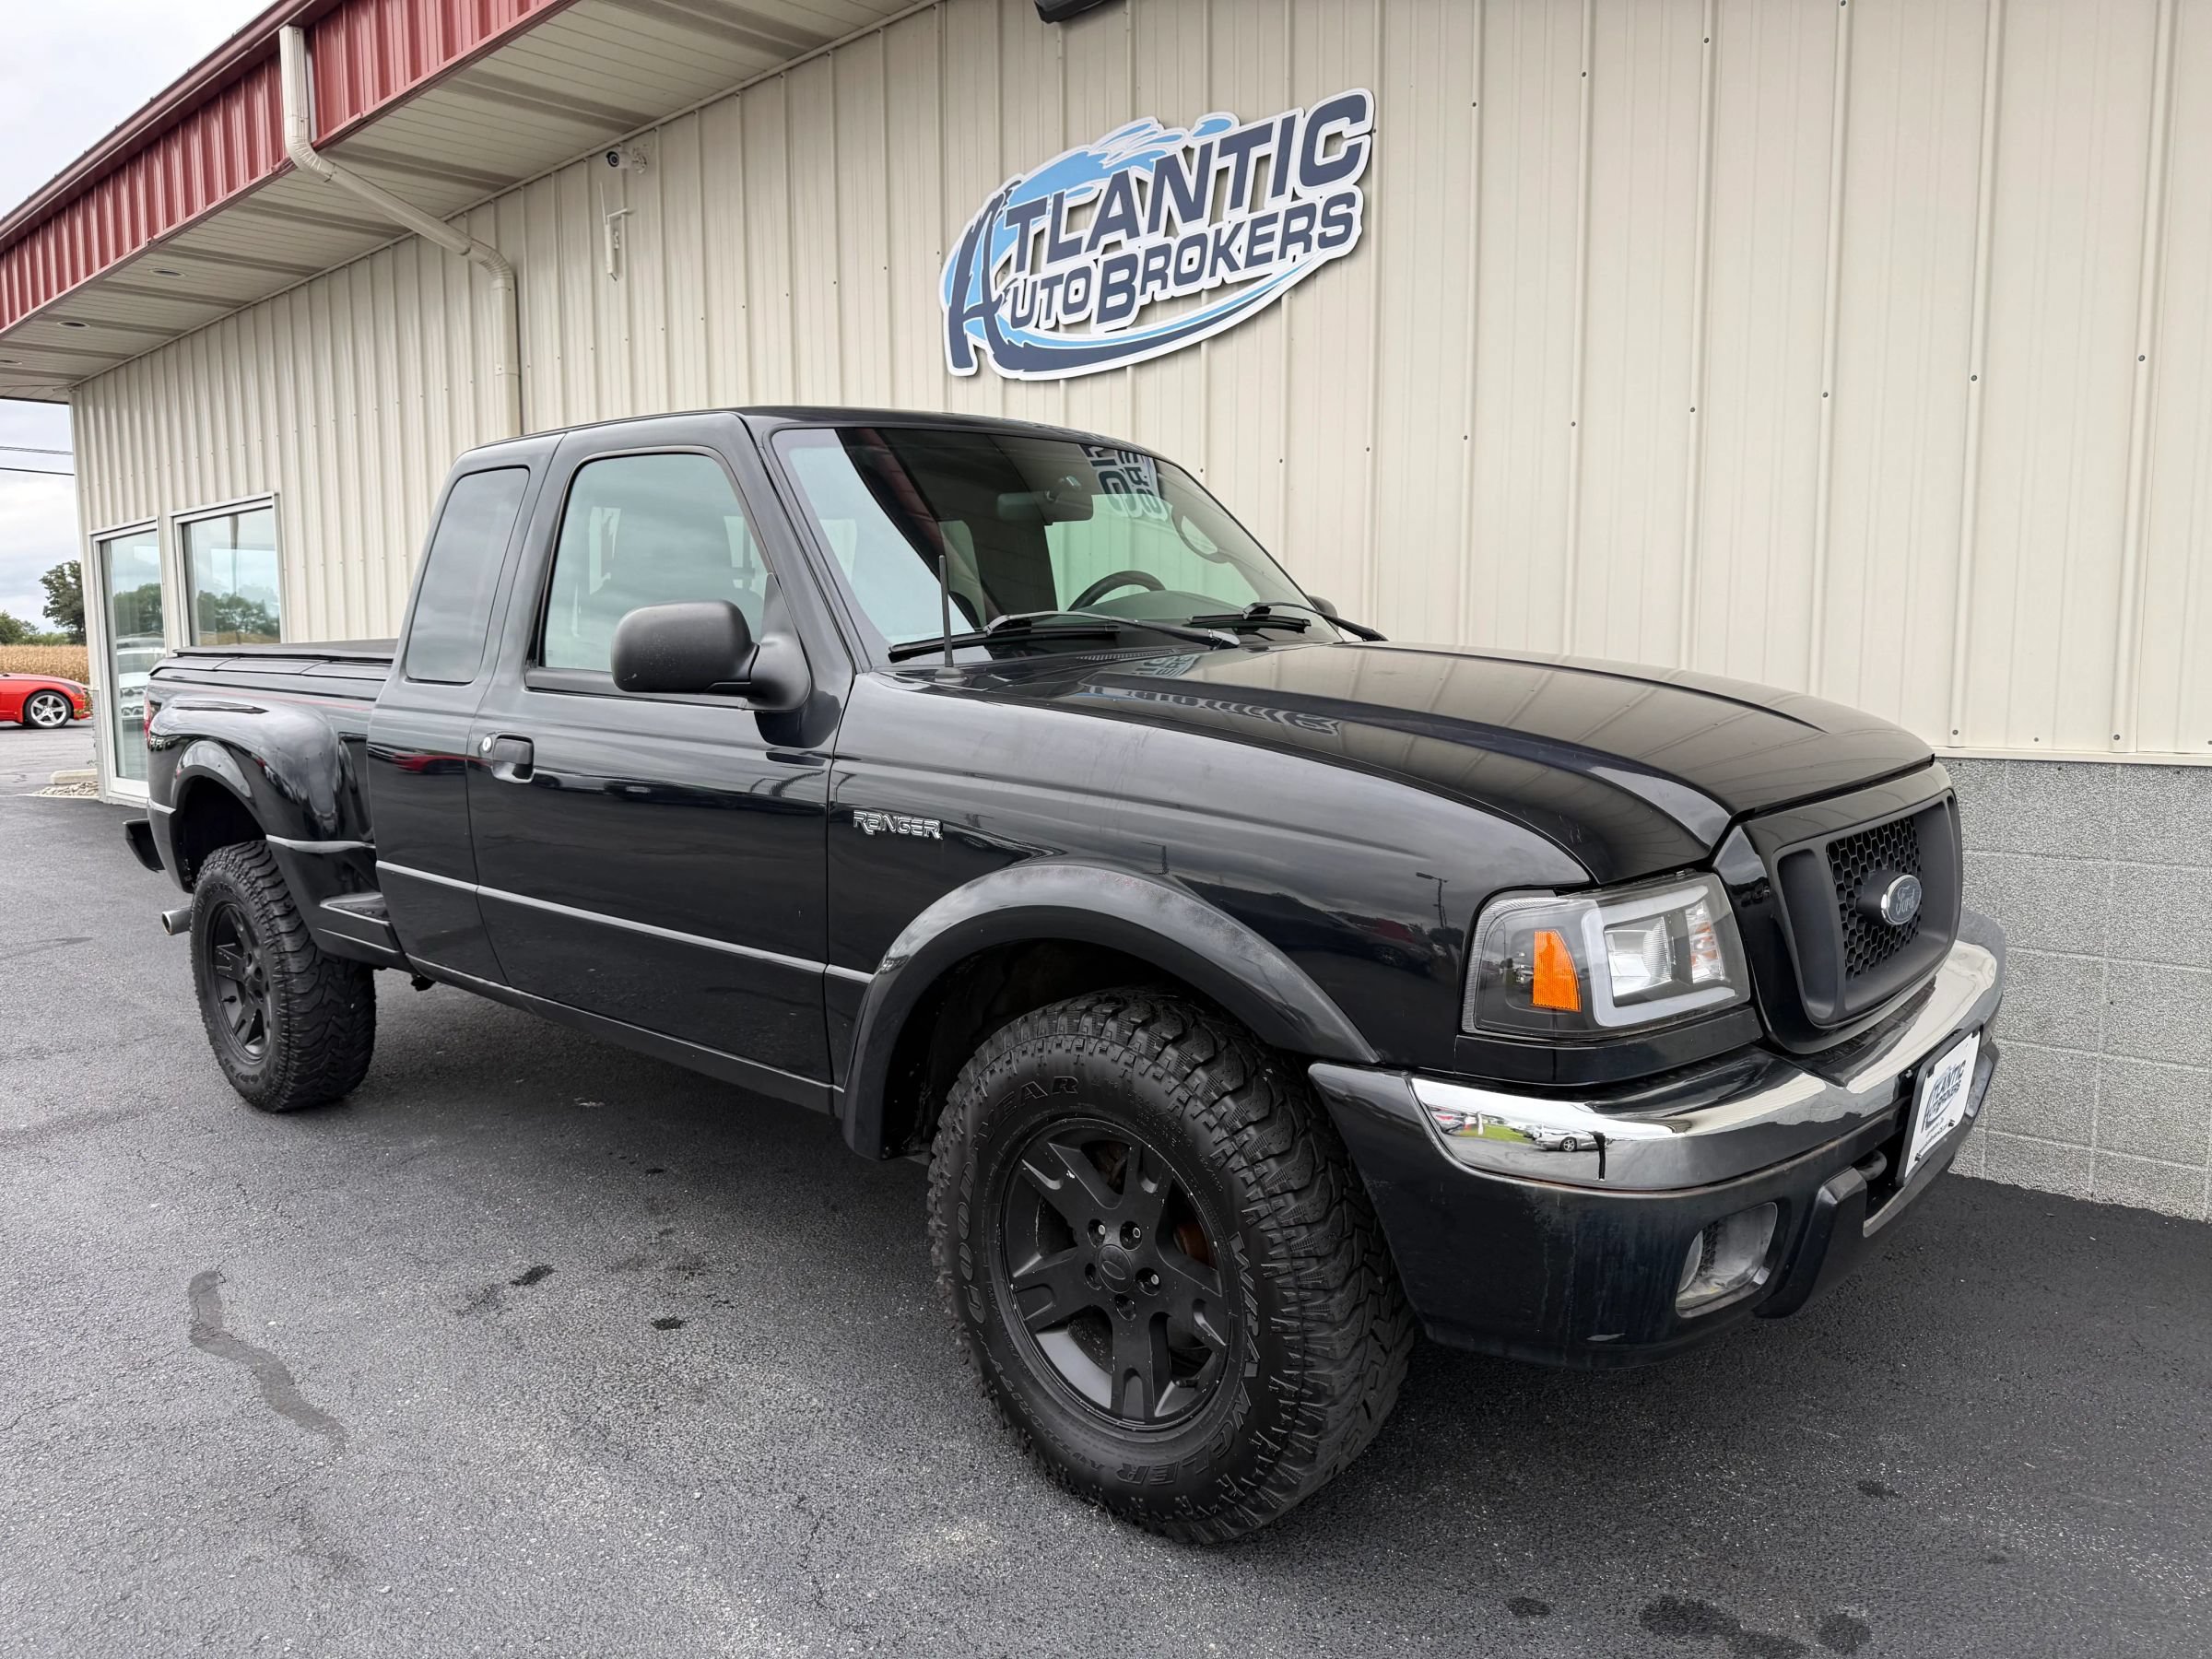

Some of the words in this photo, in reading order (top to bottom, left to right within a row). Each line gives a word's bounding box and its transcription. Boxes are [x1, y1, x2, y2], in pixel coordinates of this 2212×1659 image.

[949, 94, 1368, 369] ATLANTIC
[853, 809, 943, 840] RANGER
[1895, 885, 1916, 915] Ford
